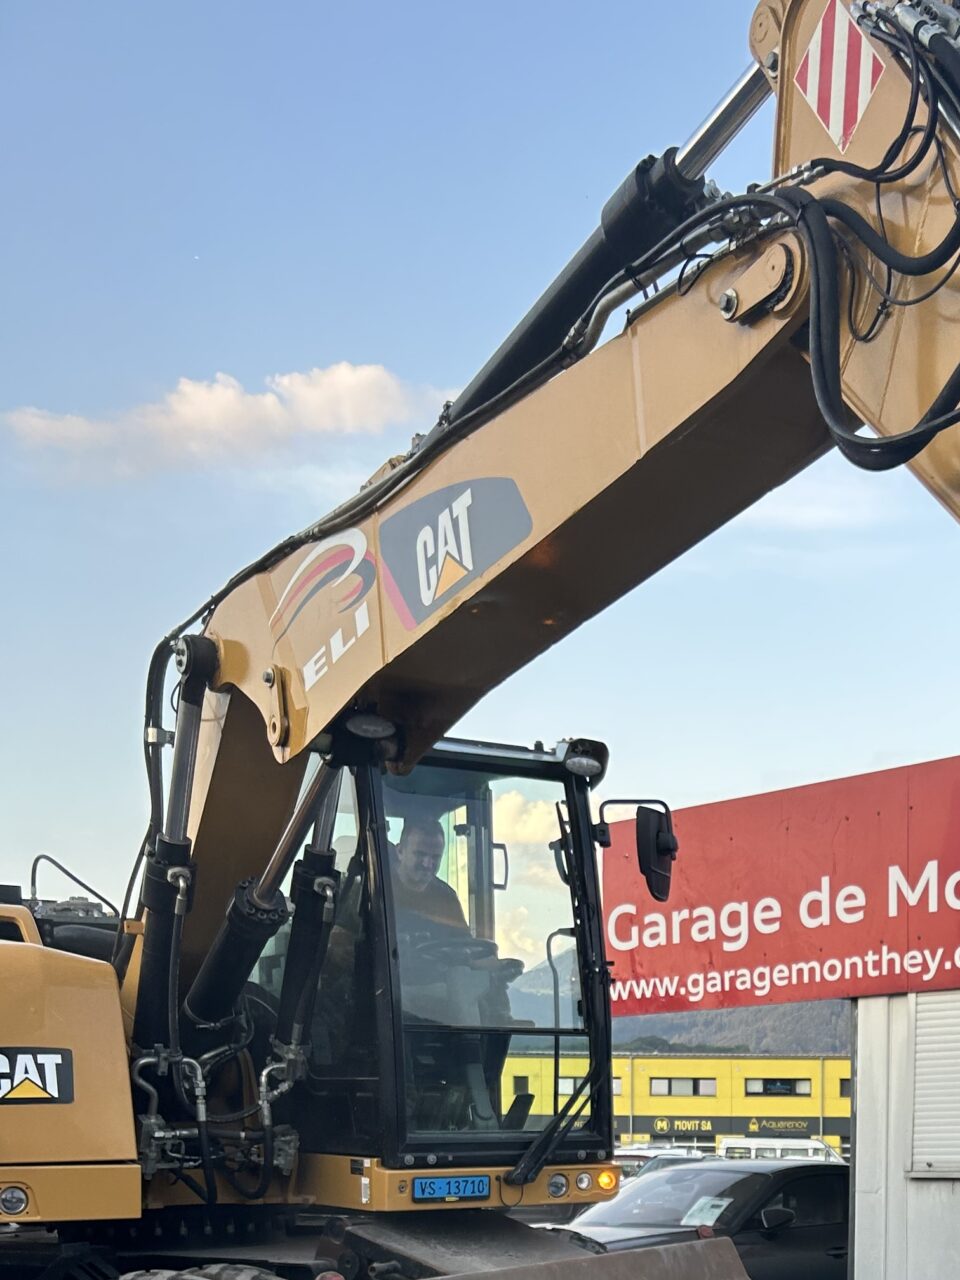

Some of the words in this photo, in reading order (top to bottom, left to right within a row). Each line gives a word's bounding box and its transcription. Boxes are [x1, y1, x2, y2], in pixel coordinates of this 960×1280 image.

[416, 487, 474, 606] CAT
[303, 600, 370, 692] ELI
[607, 903, 782, 952] Garage
[799, 875, 867, 929] de
[674, 1120, 700, 1131] MOVIT
[701, 1120, 712, 1131] SA
[420, 1181, 437, 1196] VS
[446, 1179, 485, 1195] 13710
